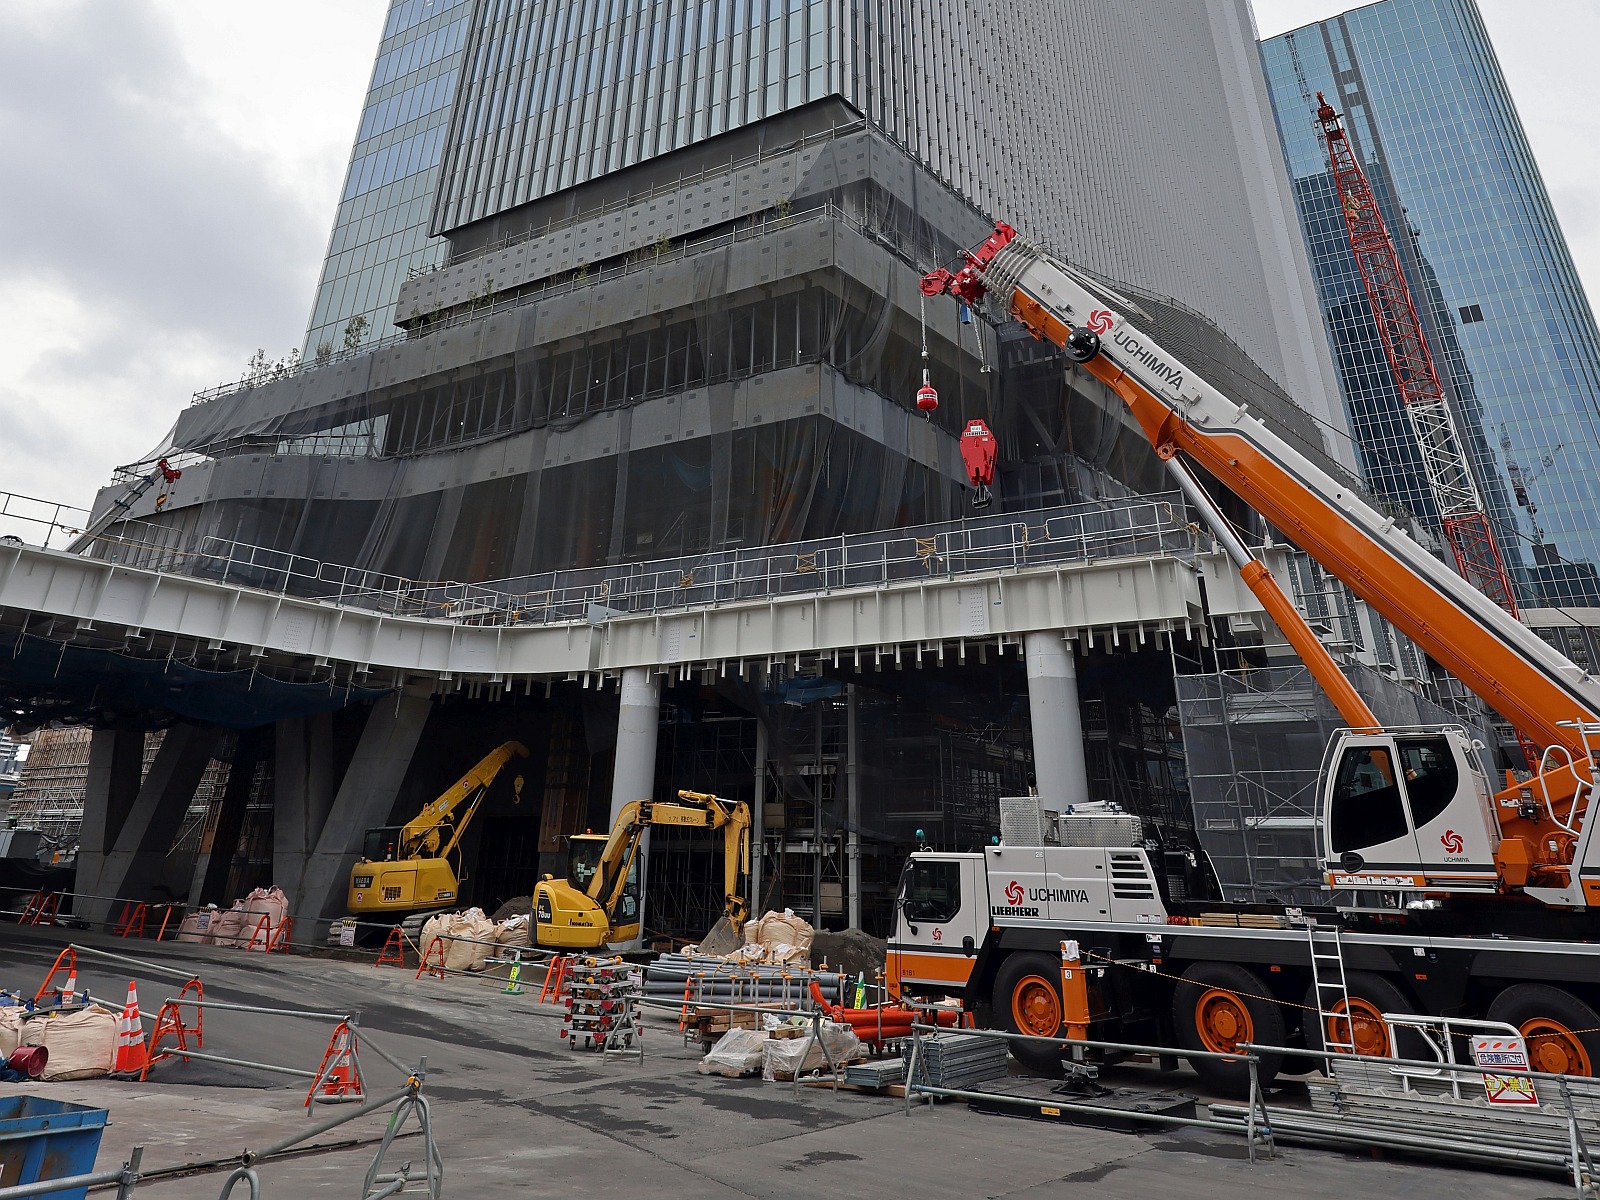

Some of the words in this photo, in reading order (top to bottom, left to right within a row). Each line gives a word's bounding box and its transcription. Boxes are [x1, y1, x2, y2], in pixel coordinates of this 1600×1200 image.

[1114, 330, 1184, 391] UCHIMIYA
[1028, 888, 1089, 904] UCHIMIYA
[991, 906, 1040, 917] LIEBHERR
[568, 918, 593, 927] KOMATSU
[1485, 1077, 1535, 1092] 立入禁止
